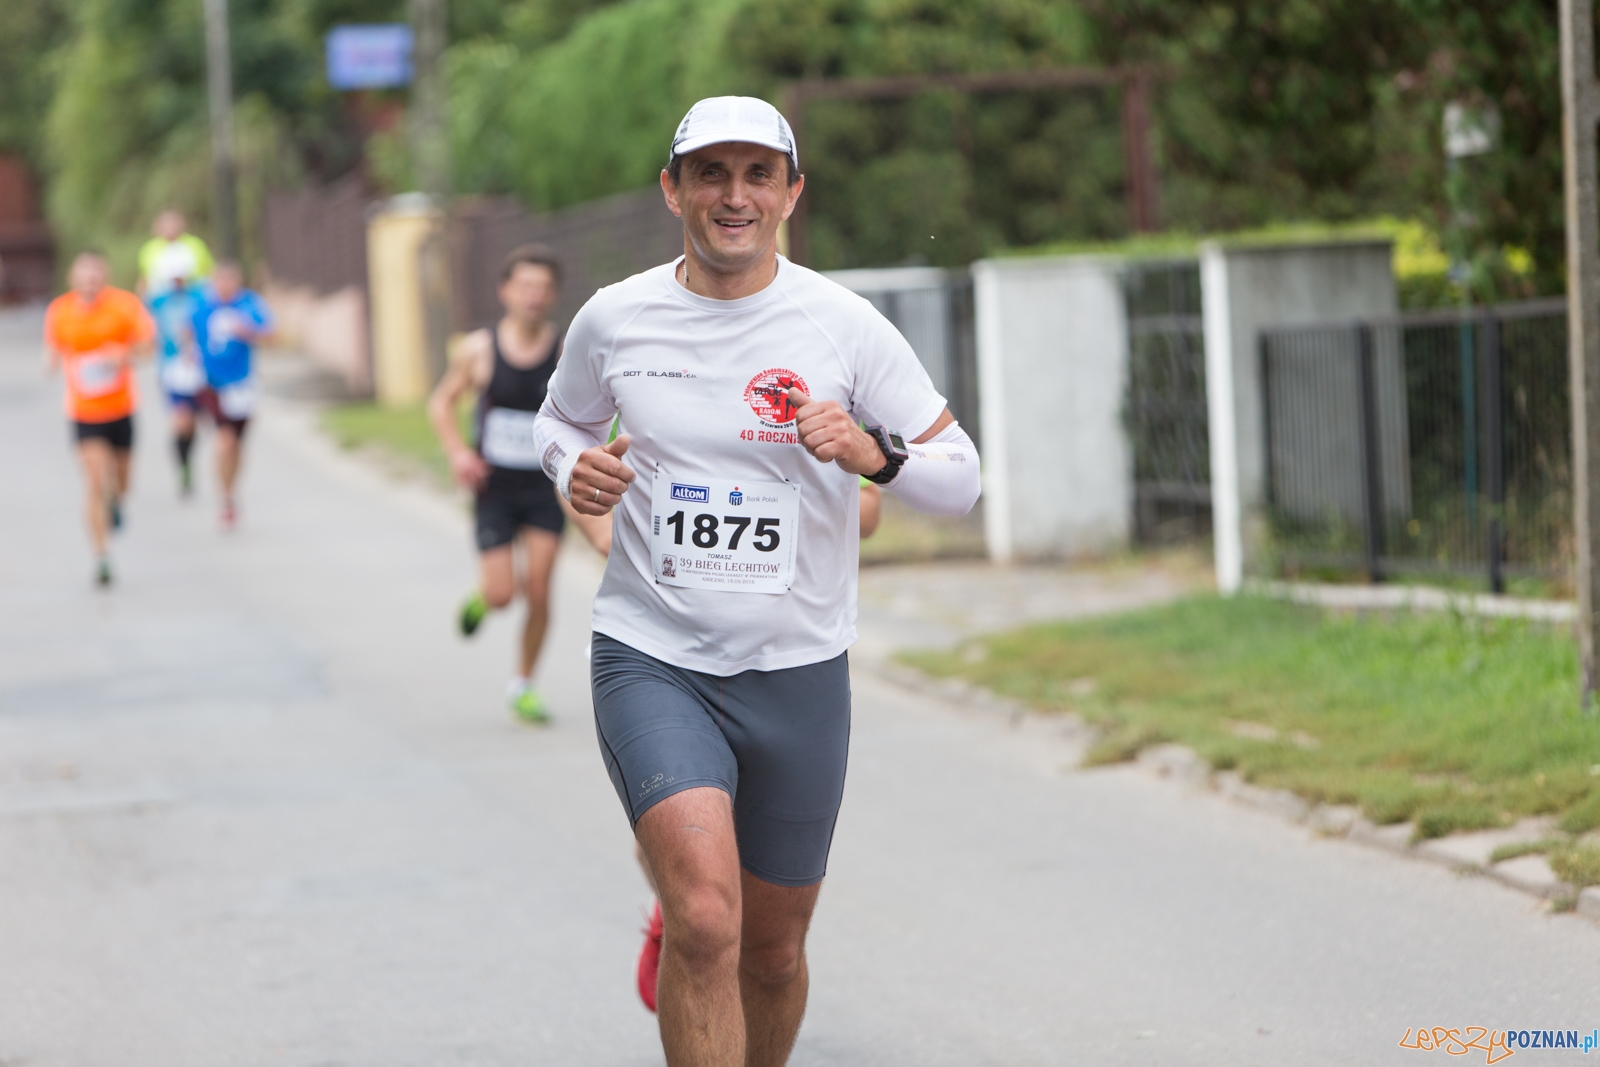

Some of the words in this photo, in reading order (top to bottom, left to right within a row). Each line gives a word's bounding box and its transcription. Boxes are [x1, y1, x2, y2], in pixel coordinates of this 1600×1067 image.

[740, 429, 754, 441] 40
[667, 510, 780, 552] 1875
[679, 557, 692, 568] 39
[695, 560, 721, 571] BIEG
[725, 561, 780, 573] LECHITÓW
